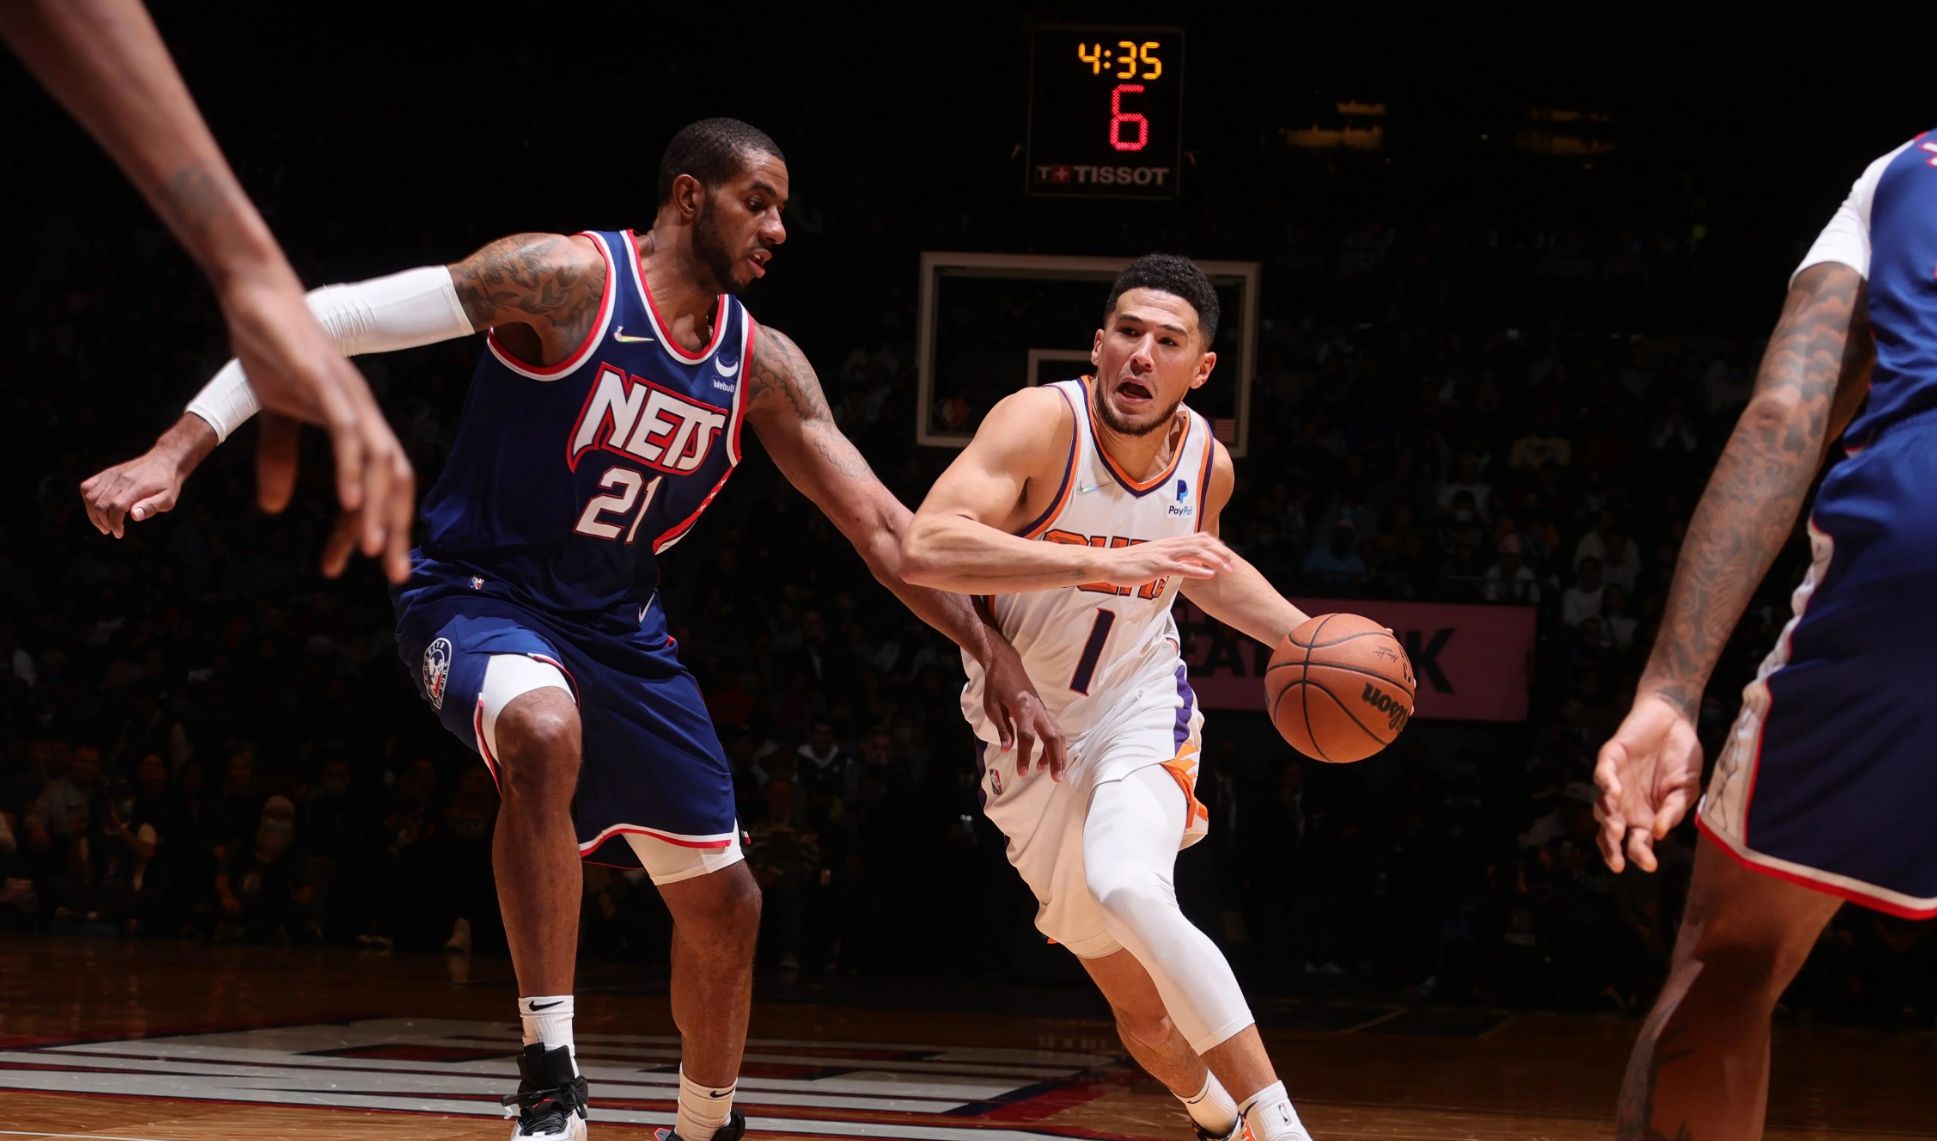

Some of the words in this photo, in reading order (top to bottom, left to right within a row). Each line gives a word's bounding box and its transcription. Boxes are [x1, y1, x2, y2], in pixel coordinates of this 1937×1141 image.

[1078, 41, 1162, 80] 4:35
[1109, 84, 1148, 151] 6
[1073, 165, 1169, 185] TISSOT
[566, 361, 729, 475] NETS
[572, 464, 663, 545] 21
[1168, 505, 1193, 516] PayPal
[1069, 607, 1116, 697] 1
